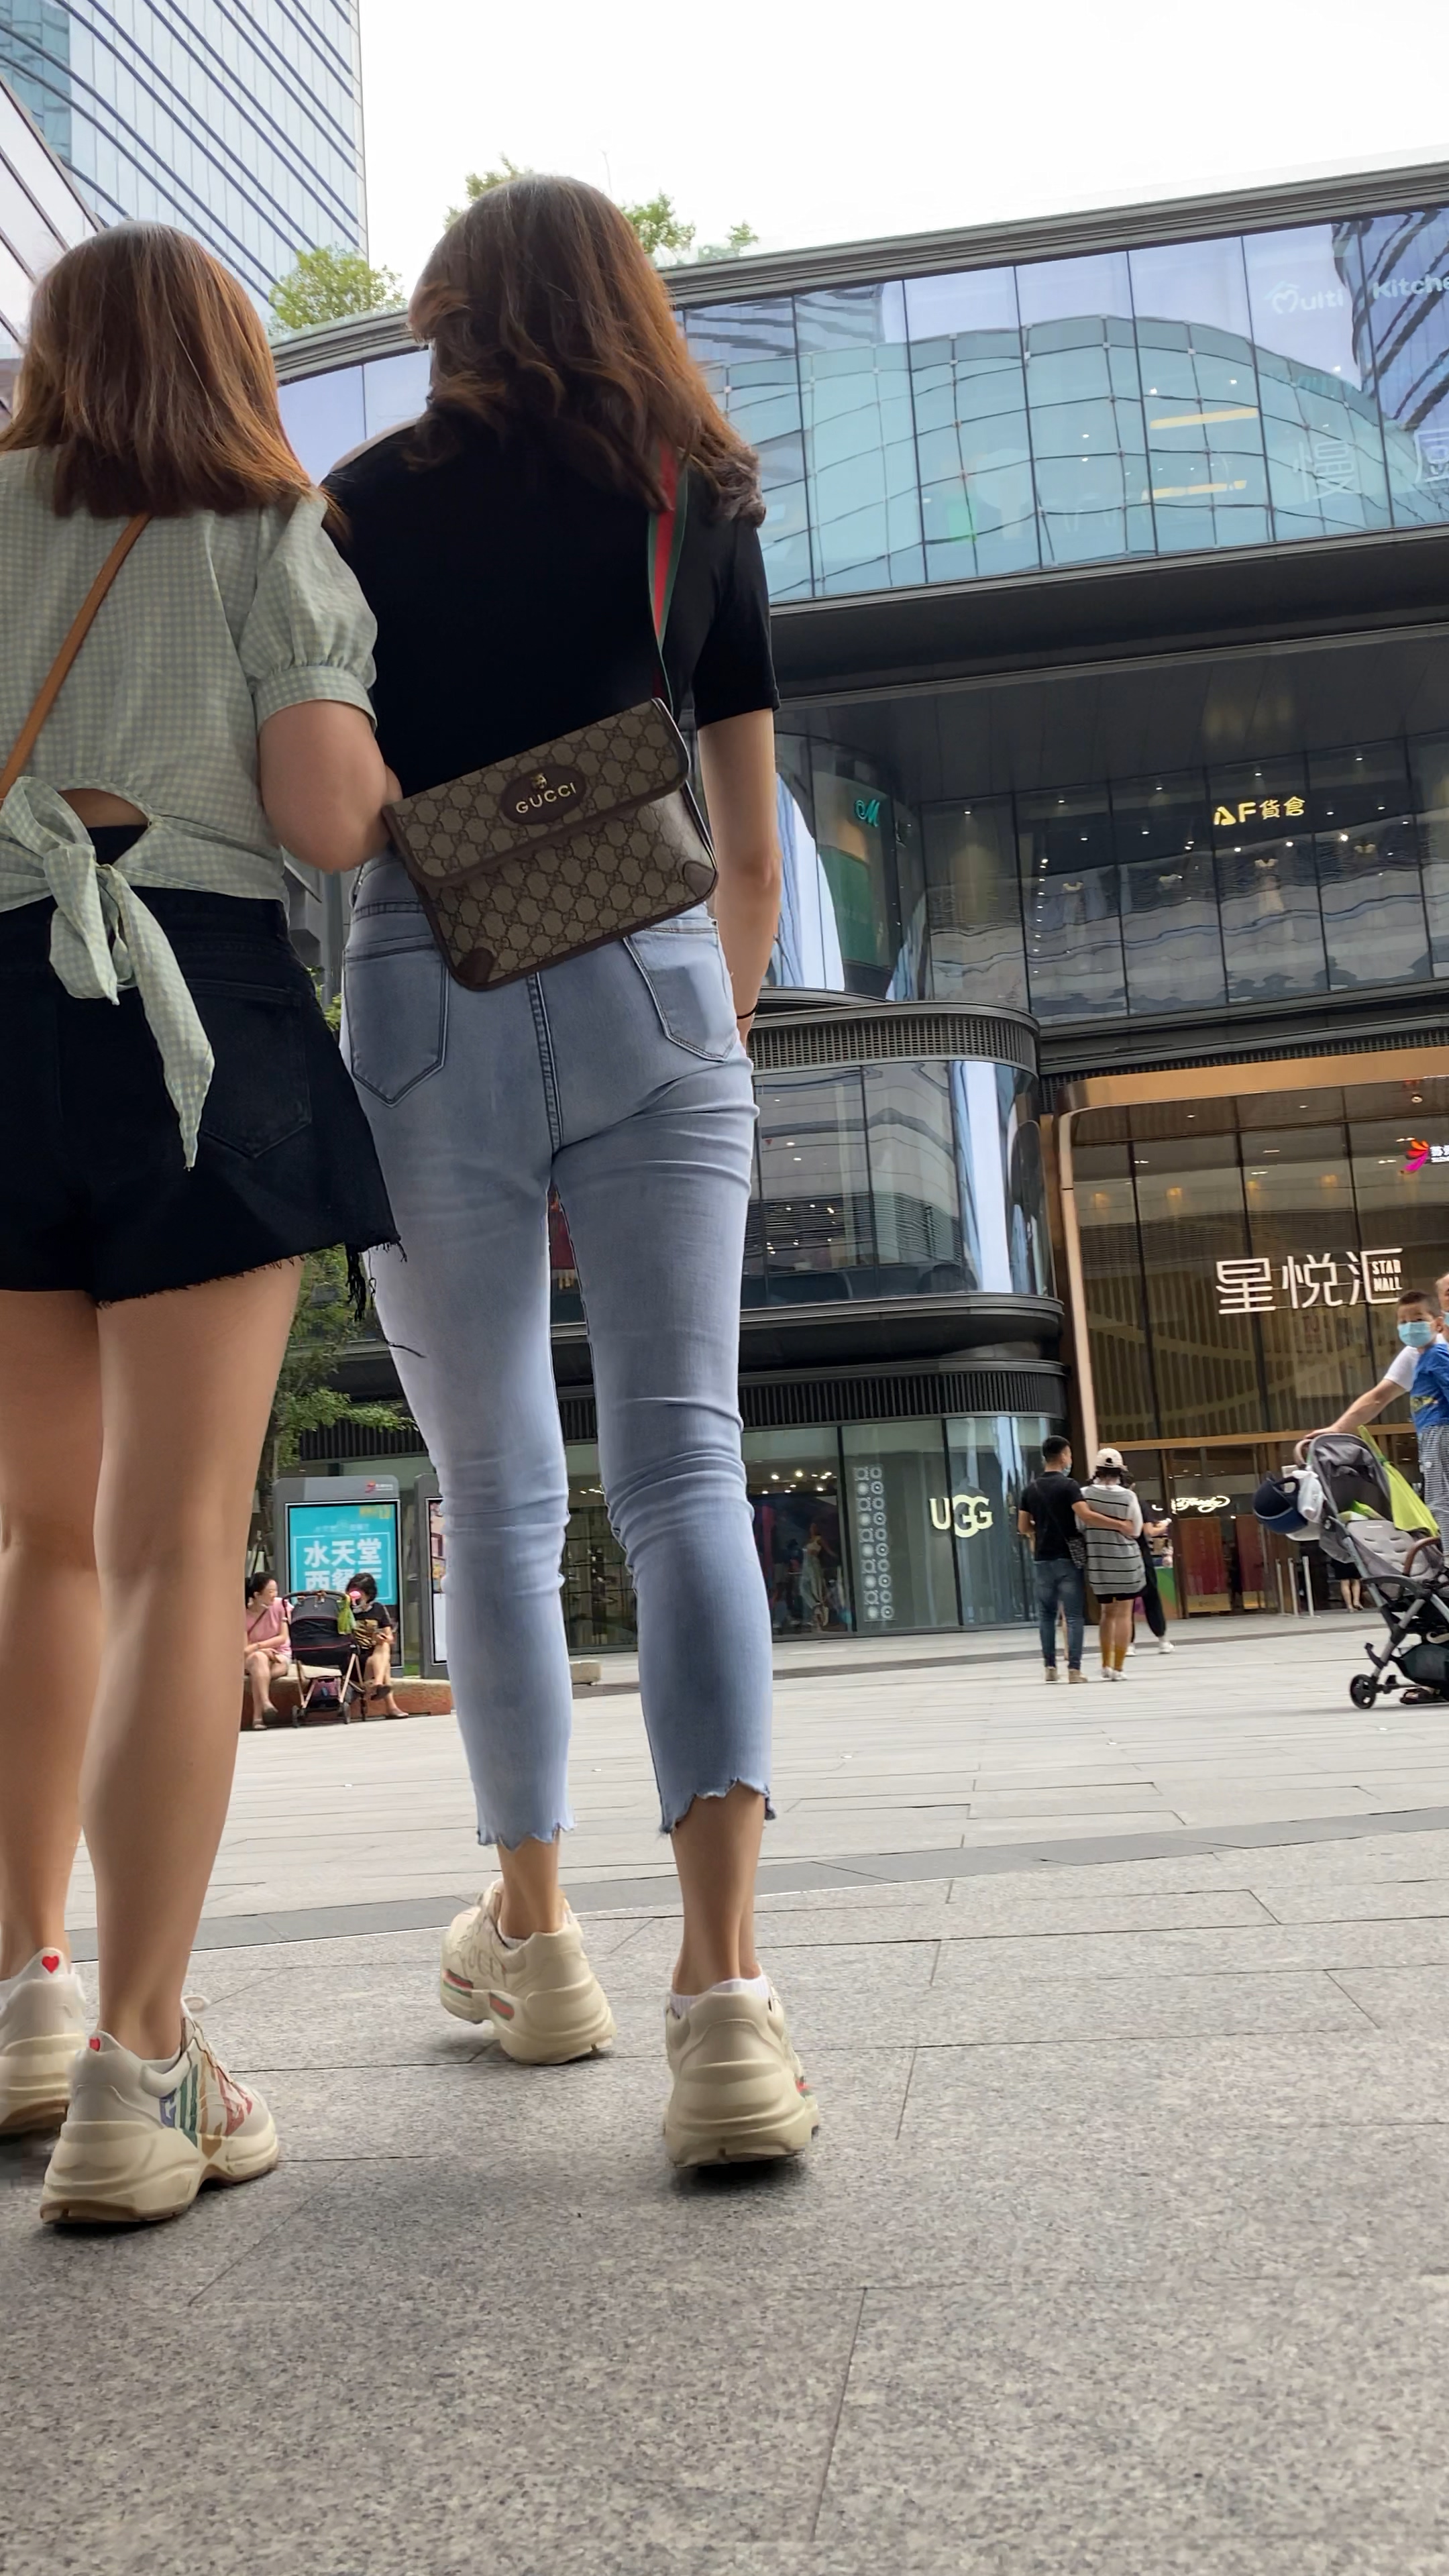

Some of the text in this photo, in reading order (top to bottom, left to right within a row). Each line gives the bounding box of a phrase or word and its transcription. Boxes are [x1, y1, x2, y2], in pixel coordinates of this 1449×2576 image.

[516, 782, 576, 814] GUCCI
[1214, 802, 1256, 826] AF
[1216, 1247, 1403, 1315] 星悦汇
[1372, 1259, 1401, 1275] STAR
[1373, 1276, 1403, 1292] MALL
[929, 1494, 994, 1538] UGG
[304, 1538, 382, 1568] 水天堂
